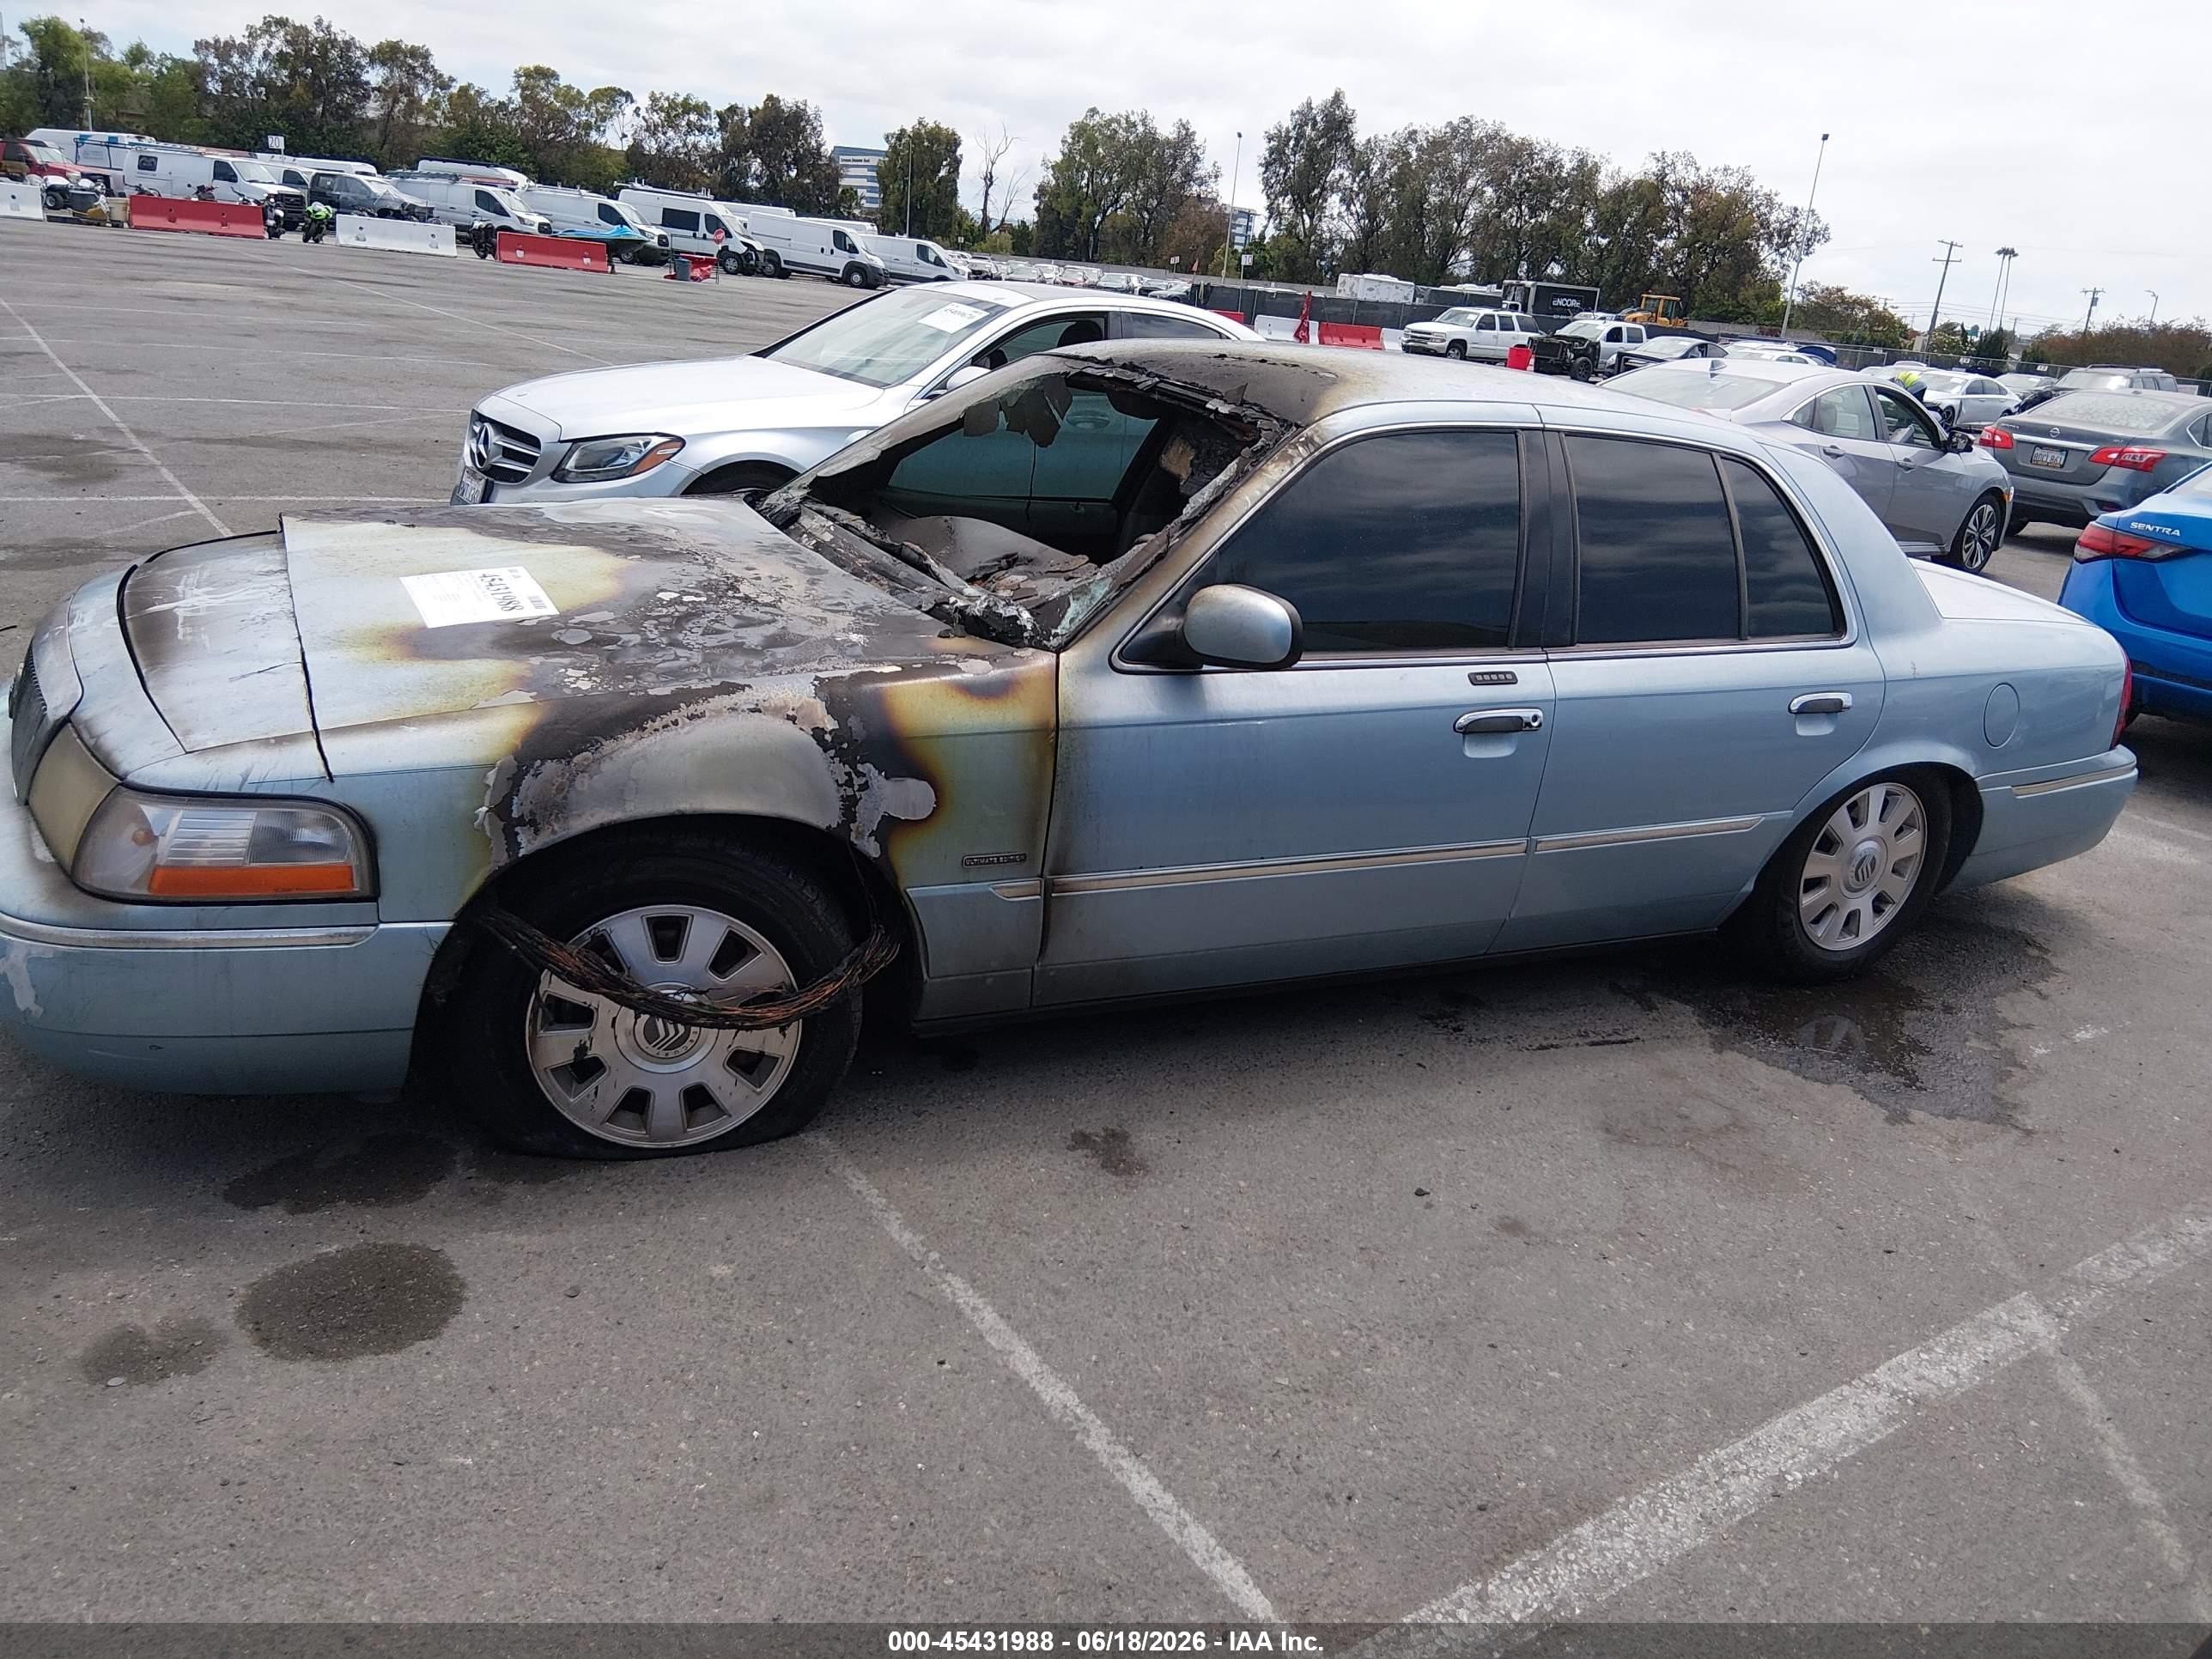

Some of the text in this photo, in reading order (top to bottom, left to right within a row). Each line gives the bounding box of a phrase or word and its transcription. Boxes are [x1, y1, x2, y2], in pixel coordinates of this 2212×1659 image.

[269, 136, 280, 148] 20
[1552, 297, 1581, 307] ENCORE
[2130, 521, 2181, 537] SENTRA
[478, 573, 525, 611] 45431988
